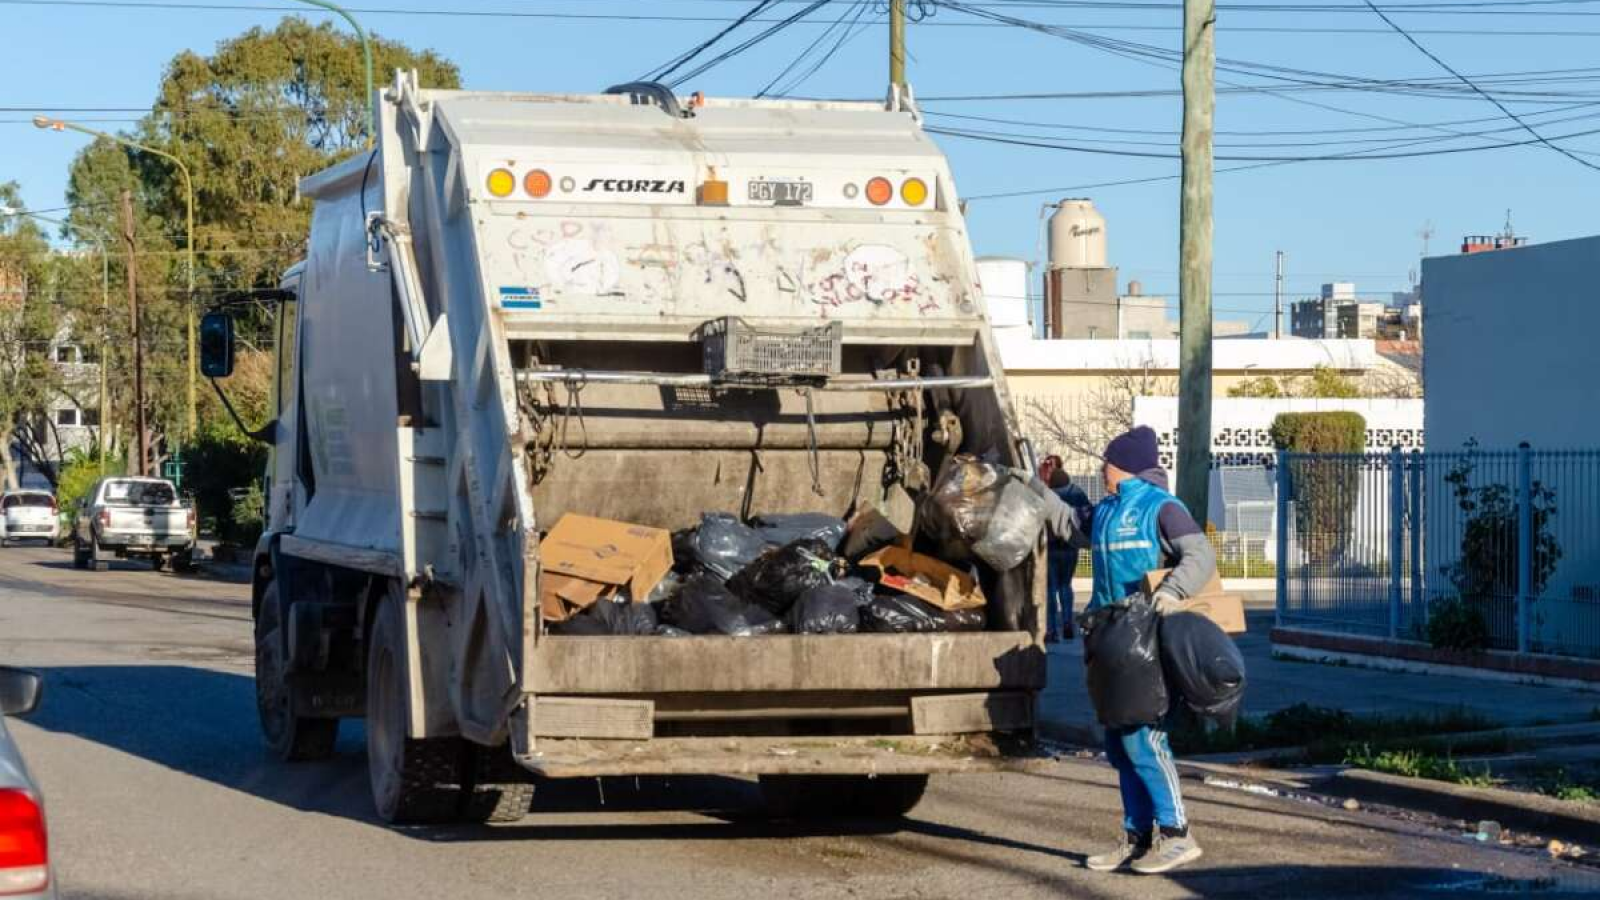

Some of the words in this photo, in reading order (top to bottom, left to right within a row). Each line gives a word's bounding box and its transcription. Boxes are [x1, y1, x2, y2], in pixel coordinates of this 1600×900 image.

[582, 178, 685, 193] SCORZA
[750, 182, 777, 199] PGY
[784, 183, 812, 201] 172
